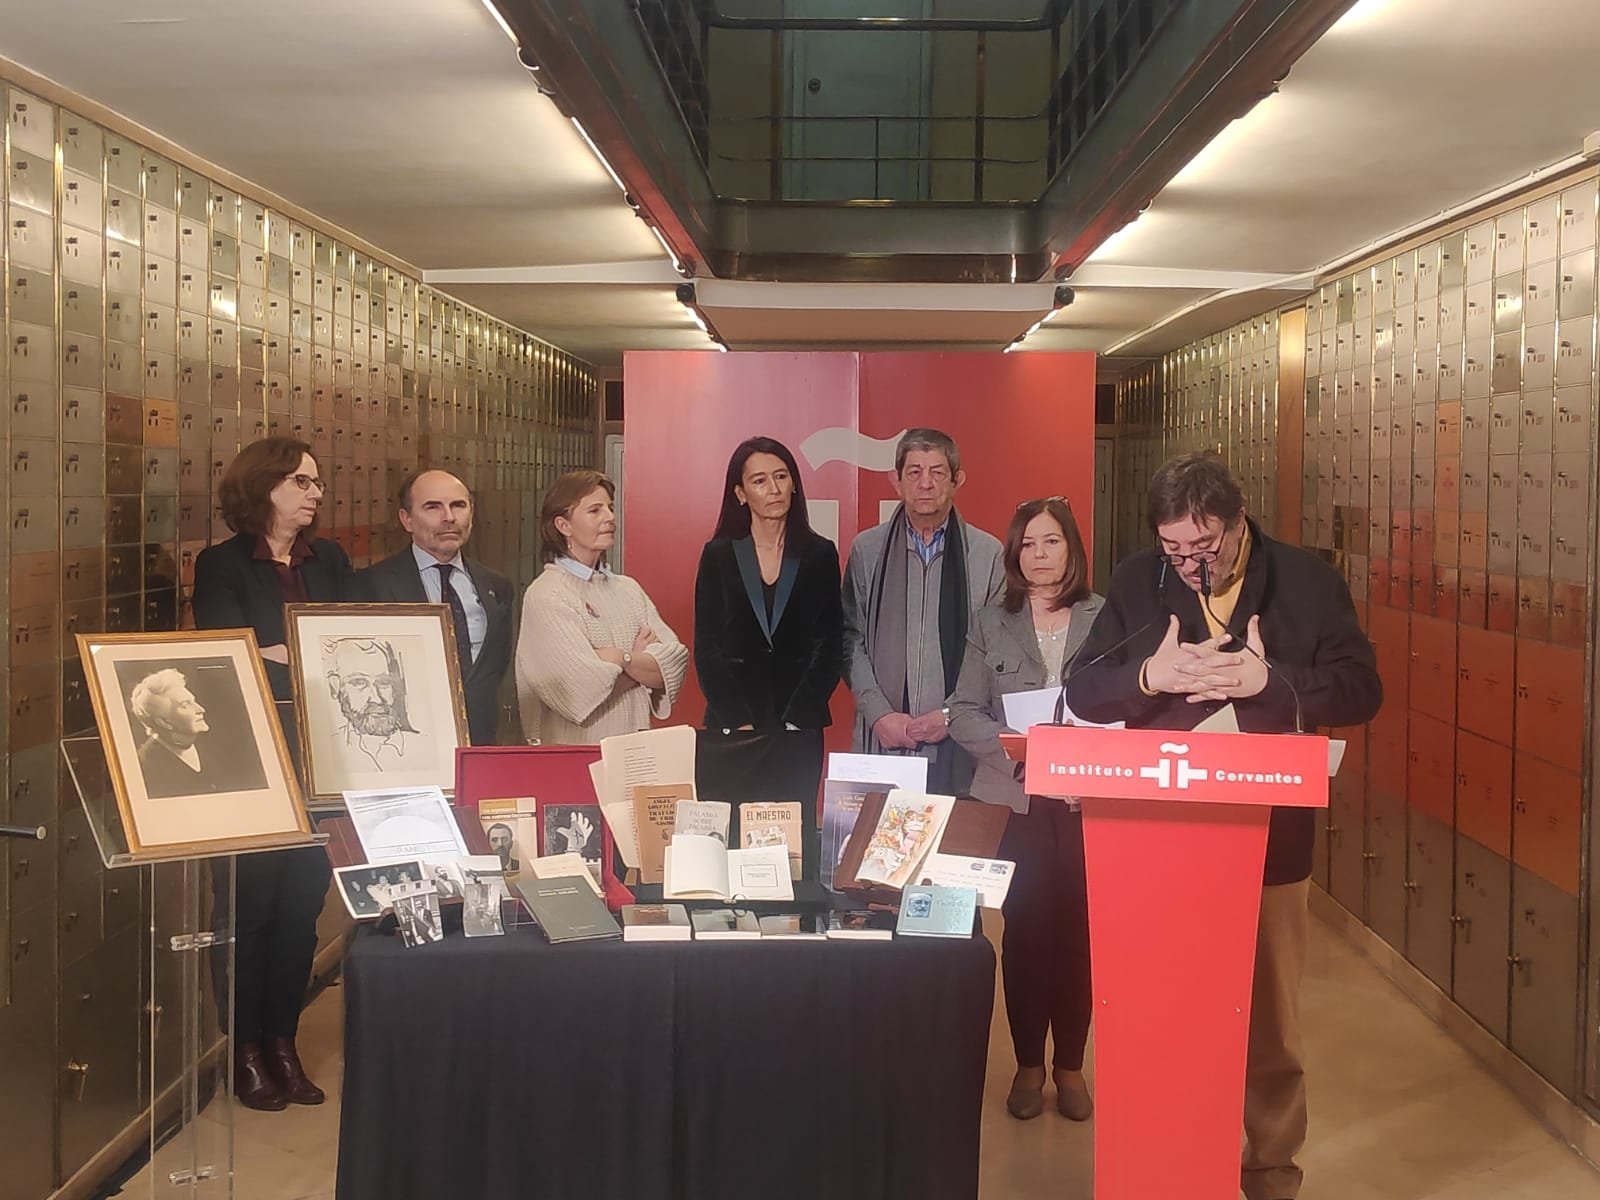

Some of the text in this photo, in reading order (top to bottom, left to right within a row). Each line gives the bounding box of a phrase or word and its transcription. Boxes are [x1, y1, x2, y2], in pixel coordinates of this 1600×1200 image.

[1050, 762, 1133, 777] Instituto
[1215, 769, 1303, 785] Cervantes
[689, 810, 719, 818] PALABRA
[746, 810, 791, 821] EL MAESTRO
